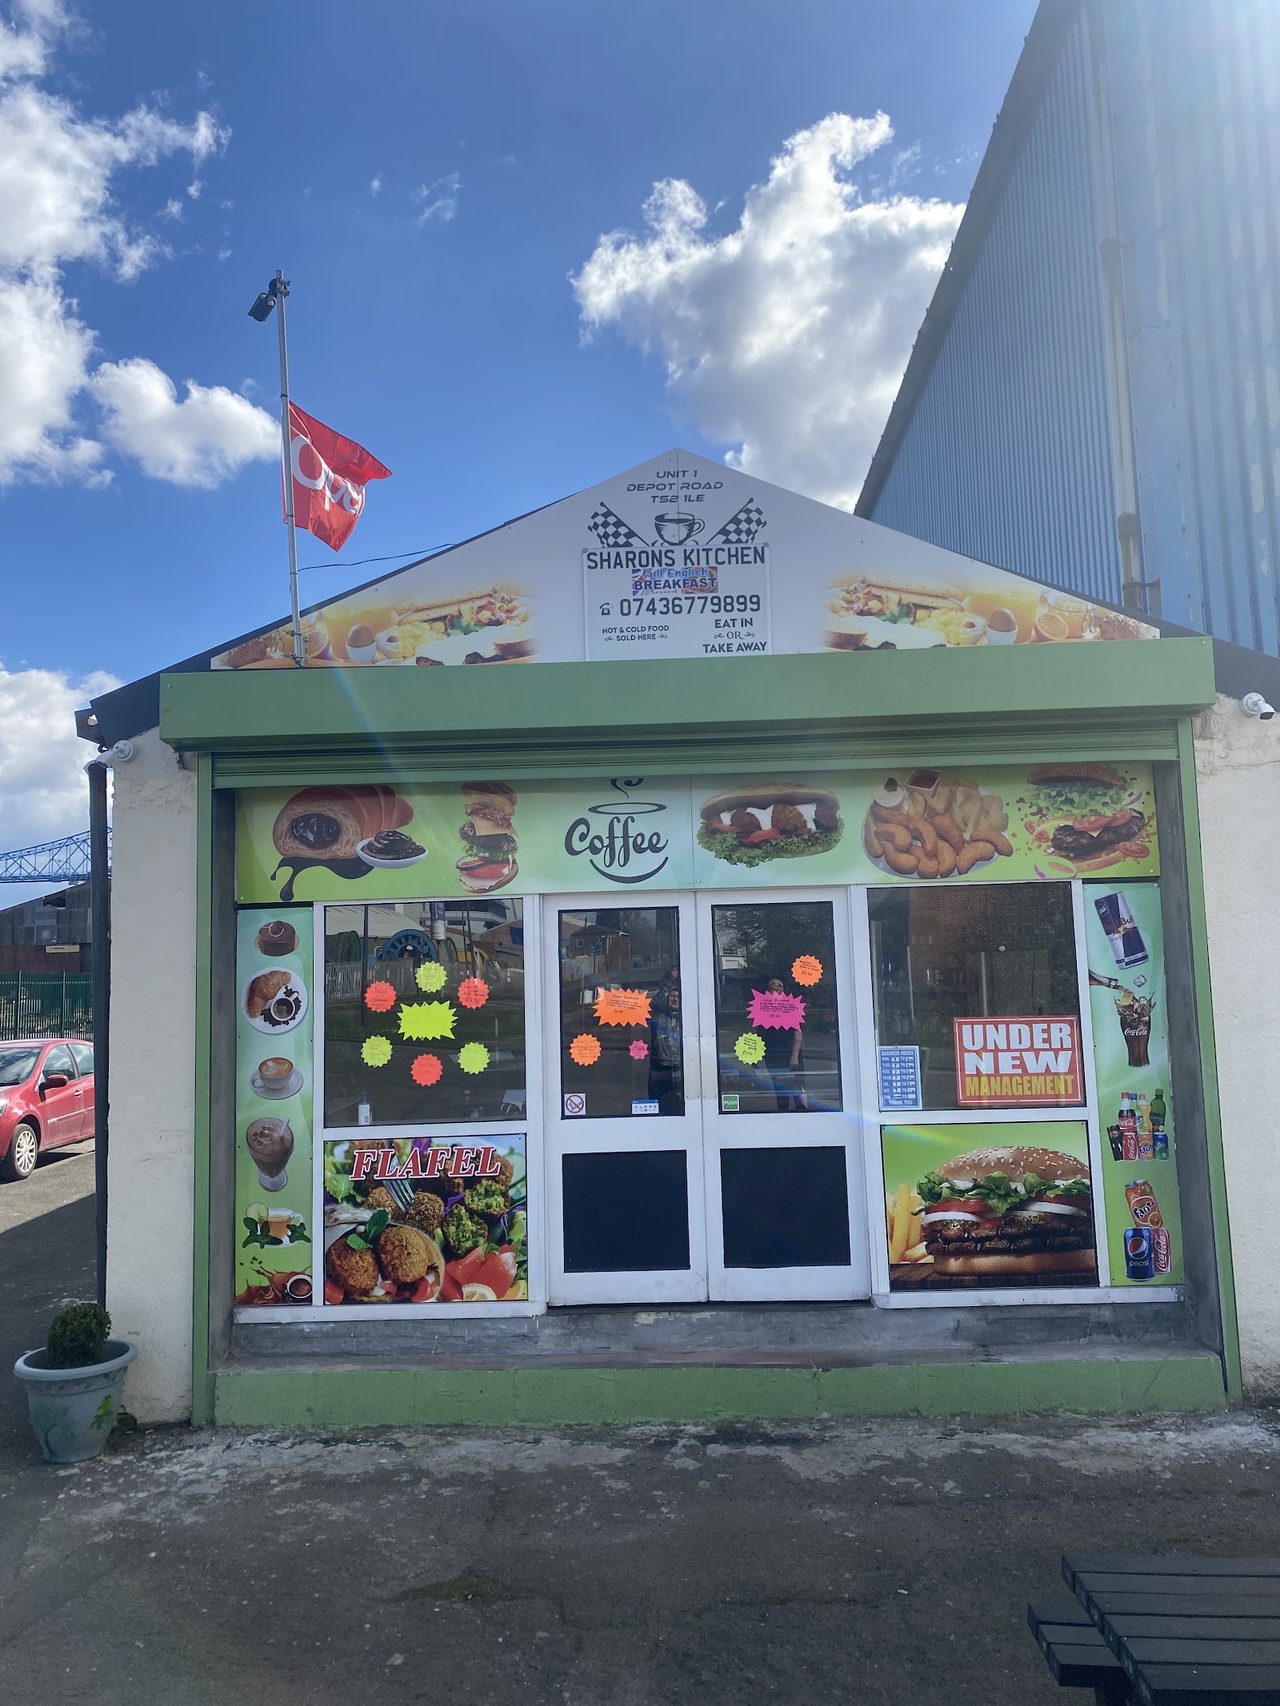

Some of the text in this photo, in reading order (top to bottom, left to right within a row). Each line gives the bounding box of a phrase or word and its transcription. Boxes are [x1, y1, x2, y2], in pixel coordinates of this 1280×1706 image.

[656, 470, 698, 479] UNIT 1
[626, 481, 724, 492] DEPOT ROAD
[650, 494, 705, 504] TS2 1LE
[587, 546, 766, 570] SHARONS KITCHEN
[643, 567, 708, 579] Full English
[634, 578, 717, 590] BREAKFAST
[619, 594, 761, 616] 07436779899
[647, 624, 670, 632] FOOD
[714, 617, 753, 628] EAT IN
[616, 634, 636, 642] SOLD
[726, 631, 745, 640] OR
[702, 641, 767, 653] TAKE AWAY
[564, 815, 669, 868] Coffee
[961, 1022, 1073, 1050] UNDER
[964, 1050, 1073, 1075] NEW
[964, 1075, 1074, 1097] MANAGEMENT
[349, 1146, 501, 1181] FLAFEL
